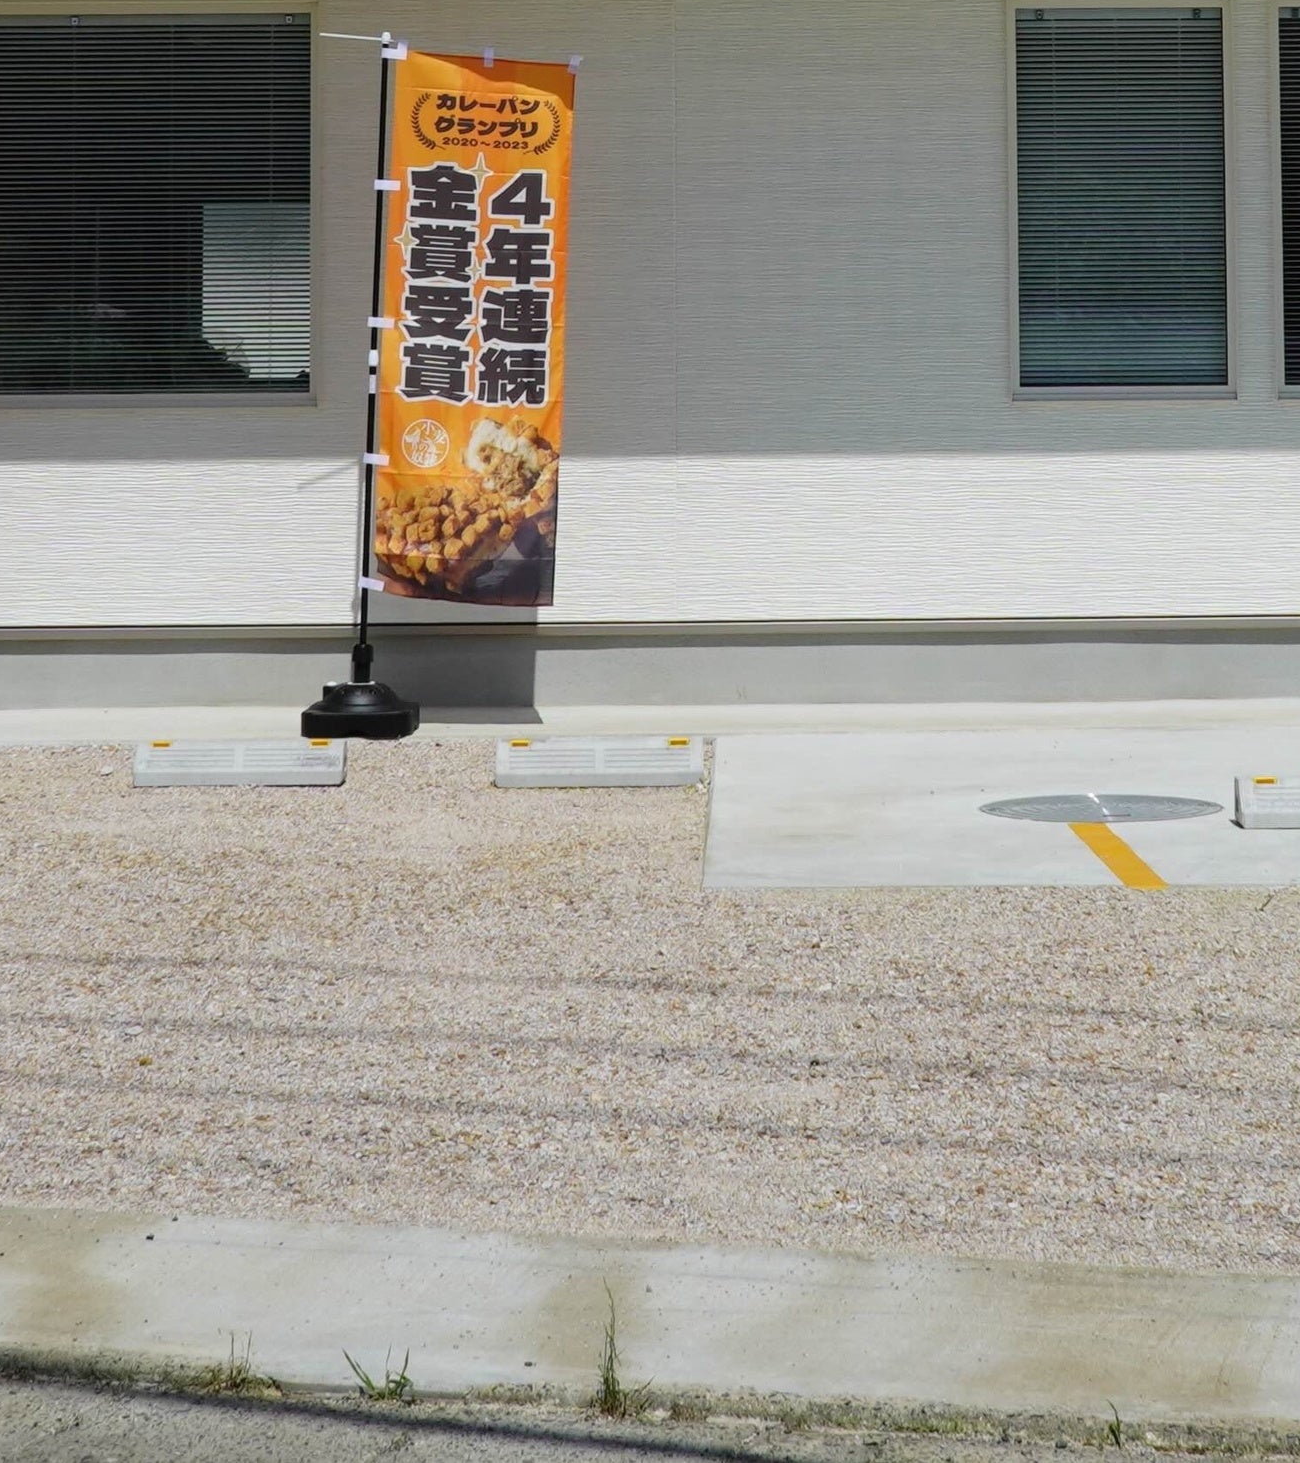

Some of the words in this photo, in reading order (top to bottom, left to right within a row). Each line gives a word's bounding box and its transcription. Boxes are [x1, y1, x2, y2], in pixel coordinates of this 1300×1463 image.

[434, 114, 539, 138] グランプリ
[436, 93, 541, 115] カレーパン
[398, 163, 479, 404] 金賞受賞
[476, 171, 553, 406] 4年連続
